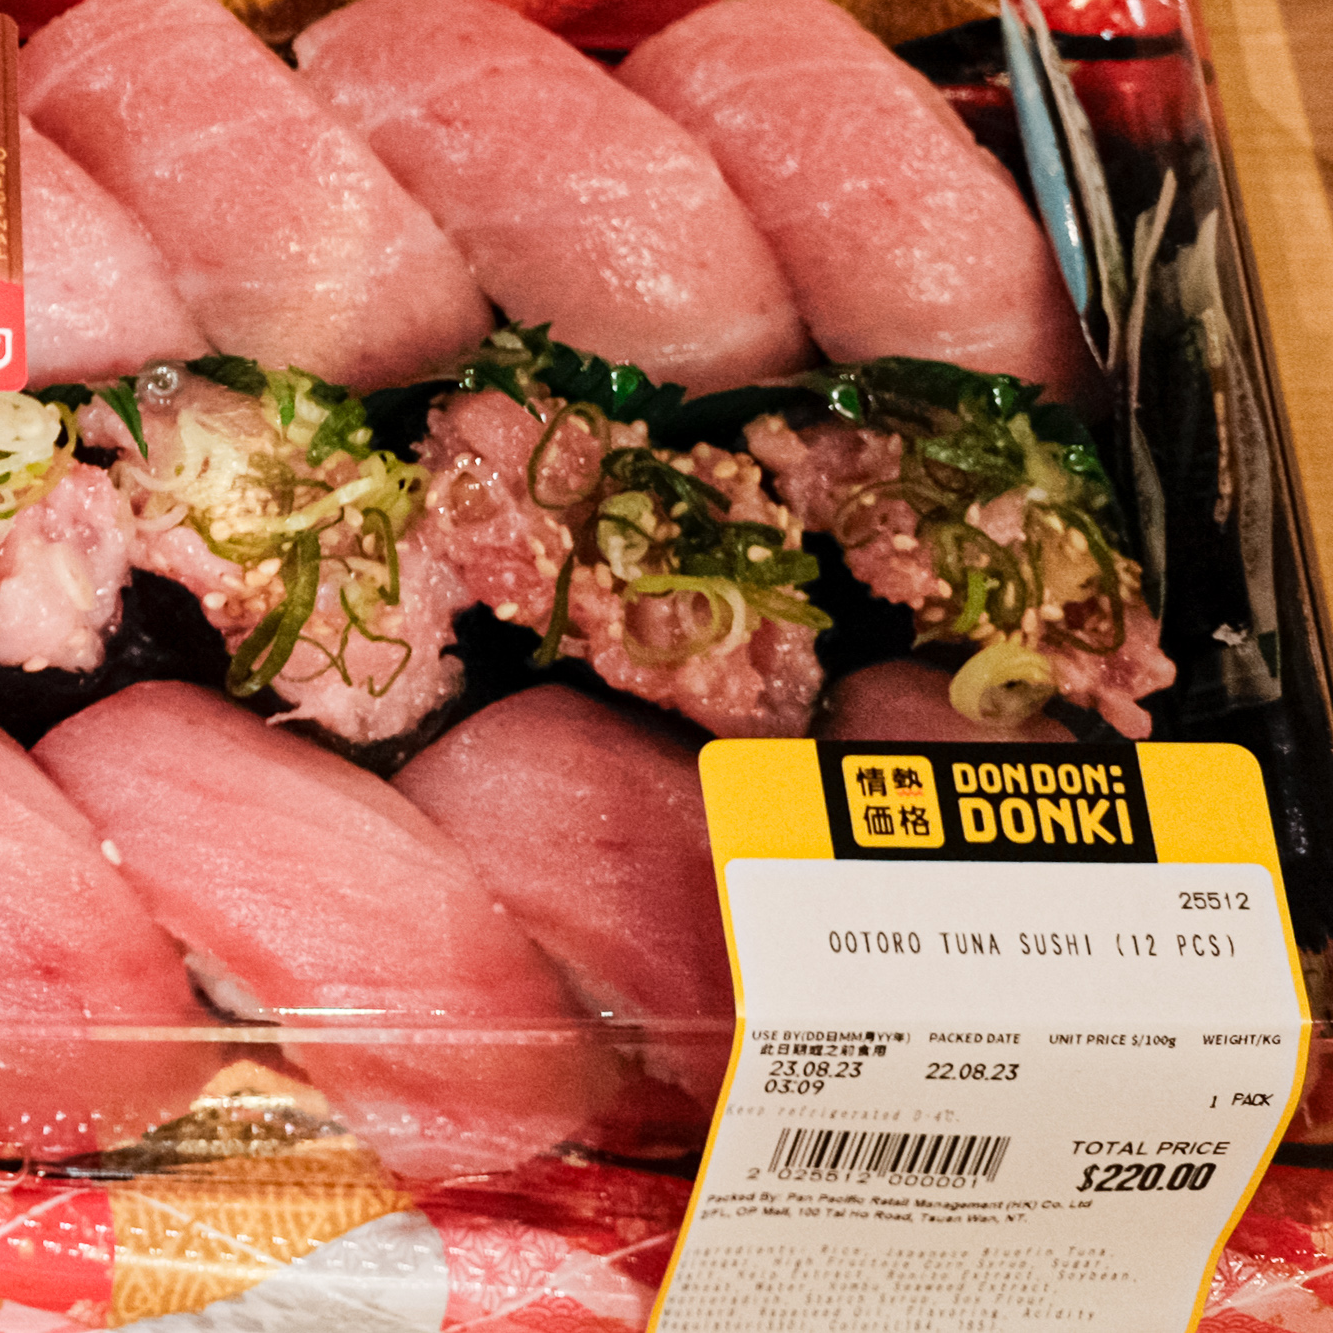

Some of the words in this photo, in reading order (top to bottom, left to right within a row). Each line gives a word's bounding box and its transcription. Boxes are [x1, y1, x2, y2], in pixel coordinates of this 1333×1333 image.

[863, 805, 931, 837] 価格
[958, 796, 1133, 845] DONKI
[1178, 891, 1251, 911] 25512
[828, 930, 921, 954] OOTORO
[940, 932, 1001, 955] TUNA
[1019, 932, 1092, 956] SUSHI
[1116, 933, 1157, 957] (12
[1176, 933, 1235, 957] PCS)
[929, 1032, 984, 1044] PACKED
[986, 1033, 1021, 1045] DATE
[1049, 1033, 1083, 1045] UNIT
[1086, 1033, 1127, 1046] PRICE
[1202, 1034, 1281, 1047] WEIGHT/KG
[769, 1060, 864, 1079] 23.08.23
[924, 1062, 1020, 1081] 22.08.23
[764, 1078, 825, 1095] 03:09
[1231, 1092, 1274, 1107] PACK
[1073, 1140, 1148, 1156] TOTAL
[1156, 1141, 1231, 1156] PRICE
[1075, 1162, 1217, 1193] $220.00
